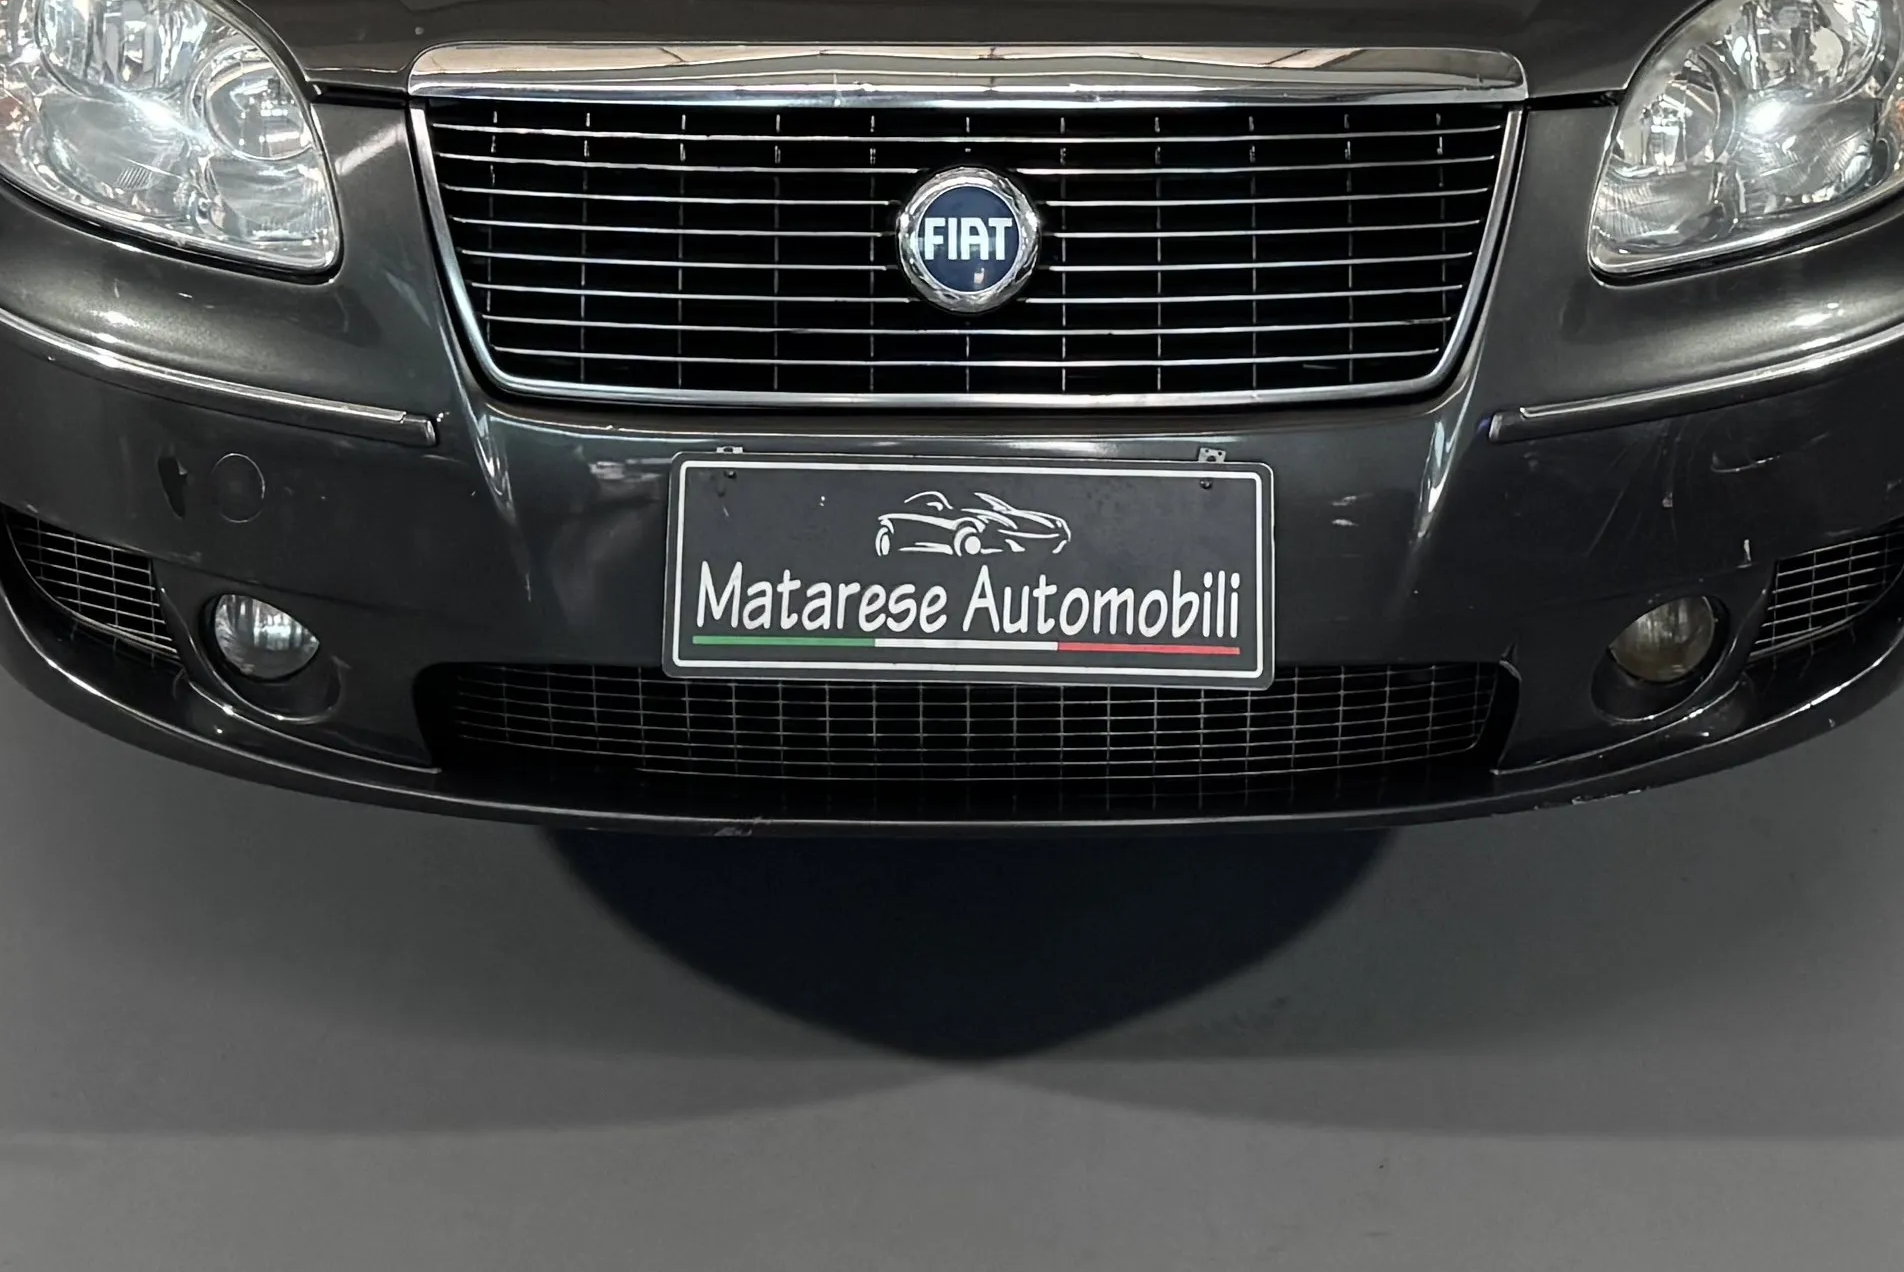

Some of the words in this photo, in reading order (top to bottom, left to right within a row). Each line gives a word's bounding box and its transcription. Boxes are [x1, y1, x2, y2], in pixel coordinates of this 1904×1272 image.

[923, 217, 1013, 261] FIAT
[696, 560, 948, 634] Matarese
[962, 564, 1241, 639] Automobili
